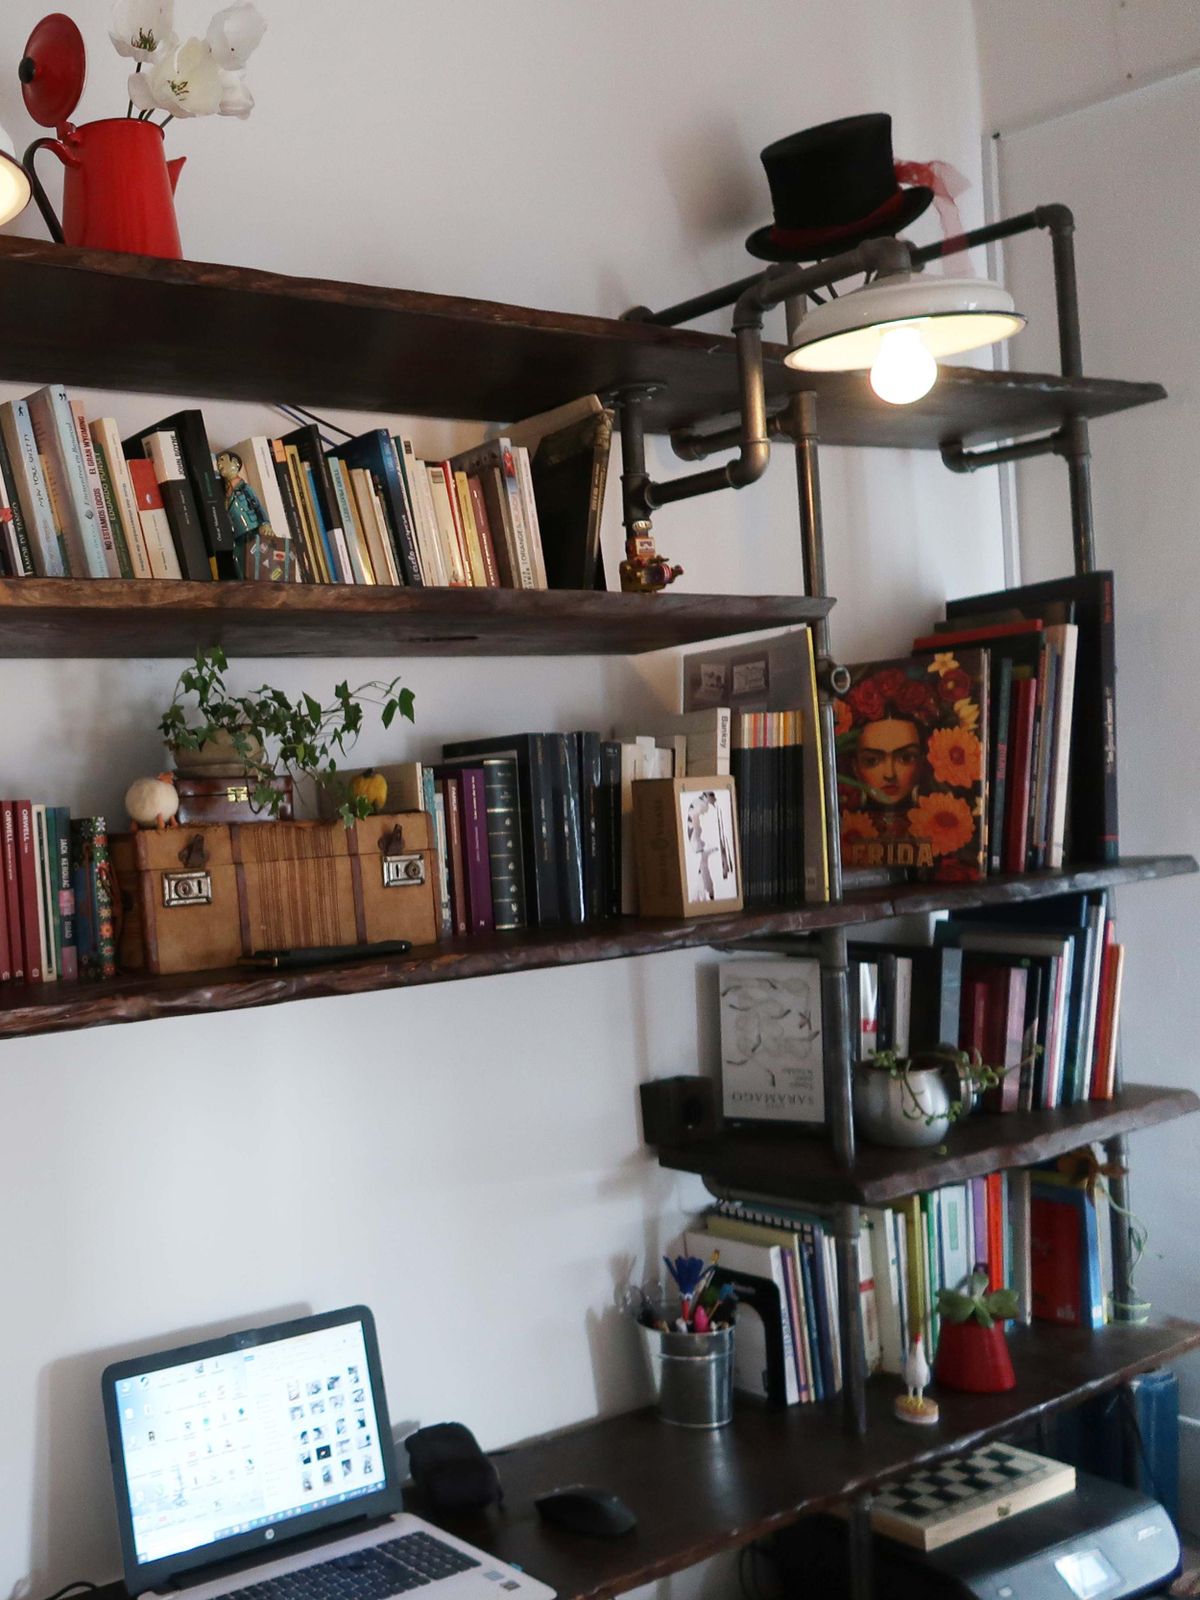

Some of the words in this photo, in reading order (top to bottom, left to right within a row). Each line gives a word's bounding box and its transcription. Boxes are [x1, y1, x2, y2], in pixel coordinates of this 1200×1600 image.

[77, 415, 91, 449] WYOMING
[86, 448, 96, 468] GRAN
[89, 467, 97, 475] EL
[93, 487, 103, 507] LOCOS
[103, 481, 116, 521] EDUARDO
[98, 506, 110, 537] ESTAMOS
[105, 538, 113, 551] NO
[719, 715, 728, 749] Banksy
[4, 810, 13, 843] ORWELL
[22, 808, 30, 843] ORWELL
[60, 838, 68, 855] JACK
[61, 857, 70, 888] KEROUAC
